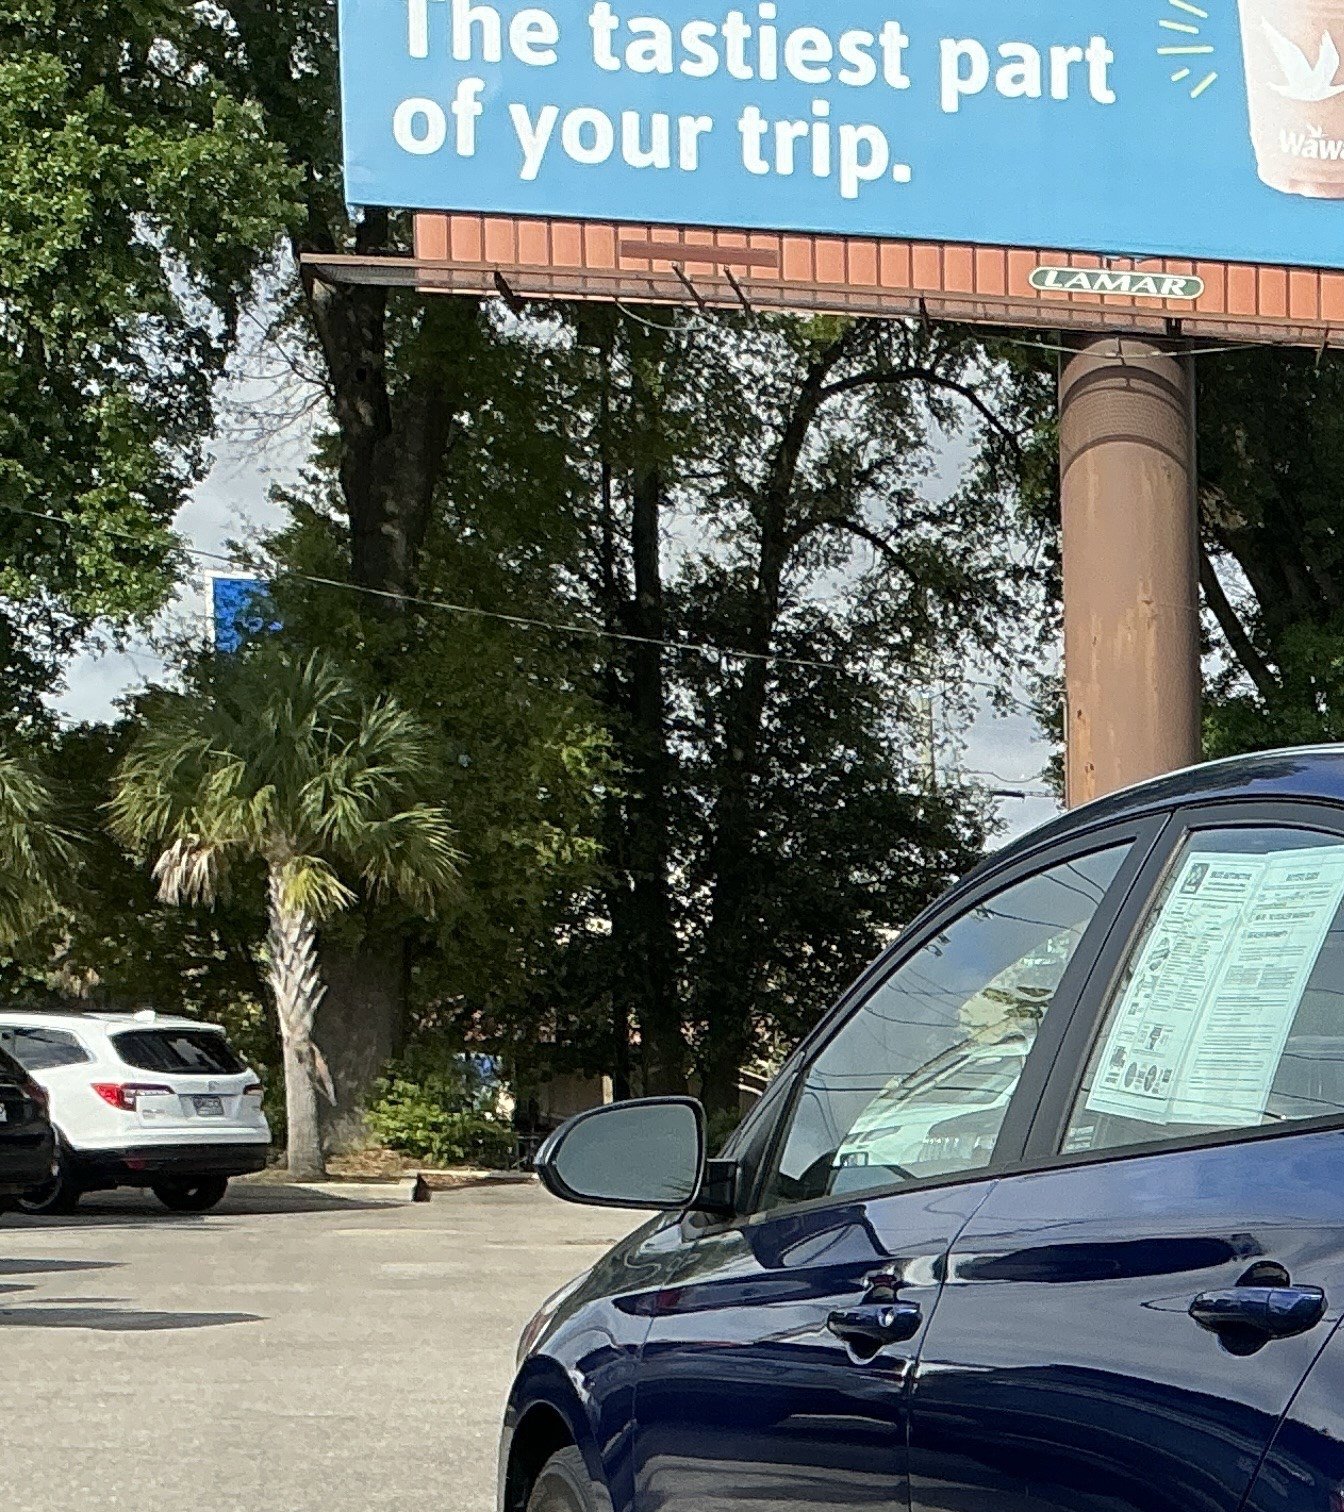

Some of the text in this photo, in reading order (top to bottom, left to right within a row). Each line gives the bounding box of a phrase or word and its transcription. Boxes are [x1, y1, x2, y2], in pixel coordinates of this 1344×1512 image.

[588, 2, 911, 90] tastiest
[940, 36, 1116, 114] part
[393, 77, 912, 199] of your trip.
[1044, 269, 1187, 296] LAMAR
